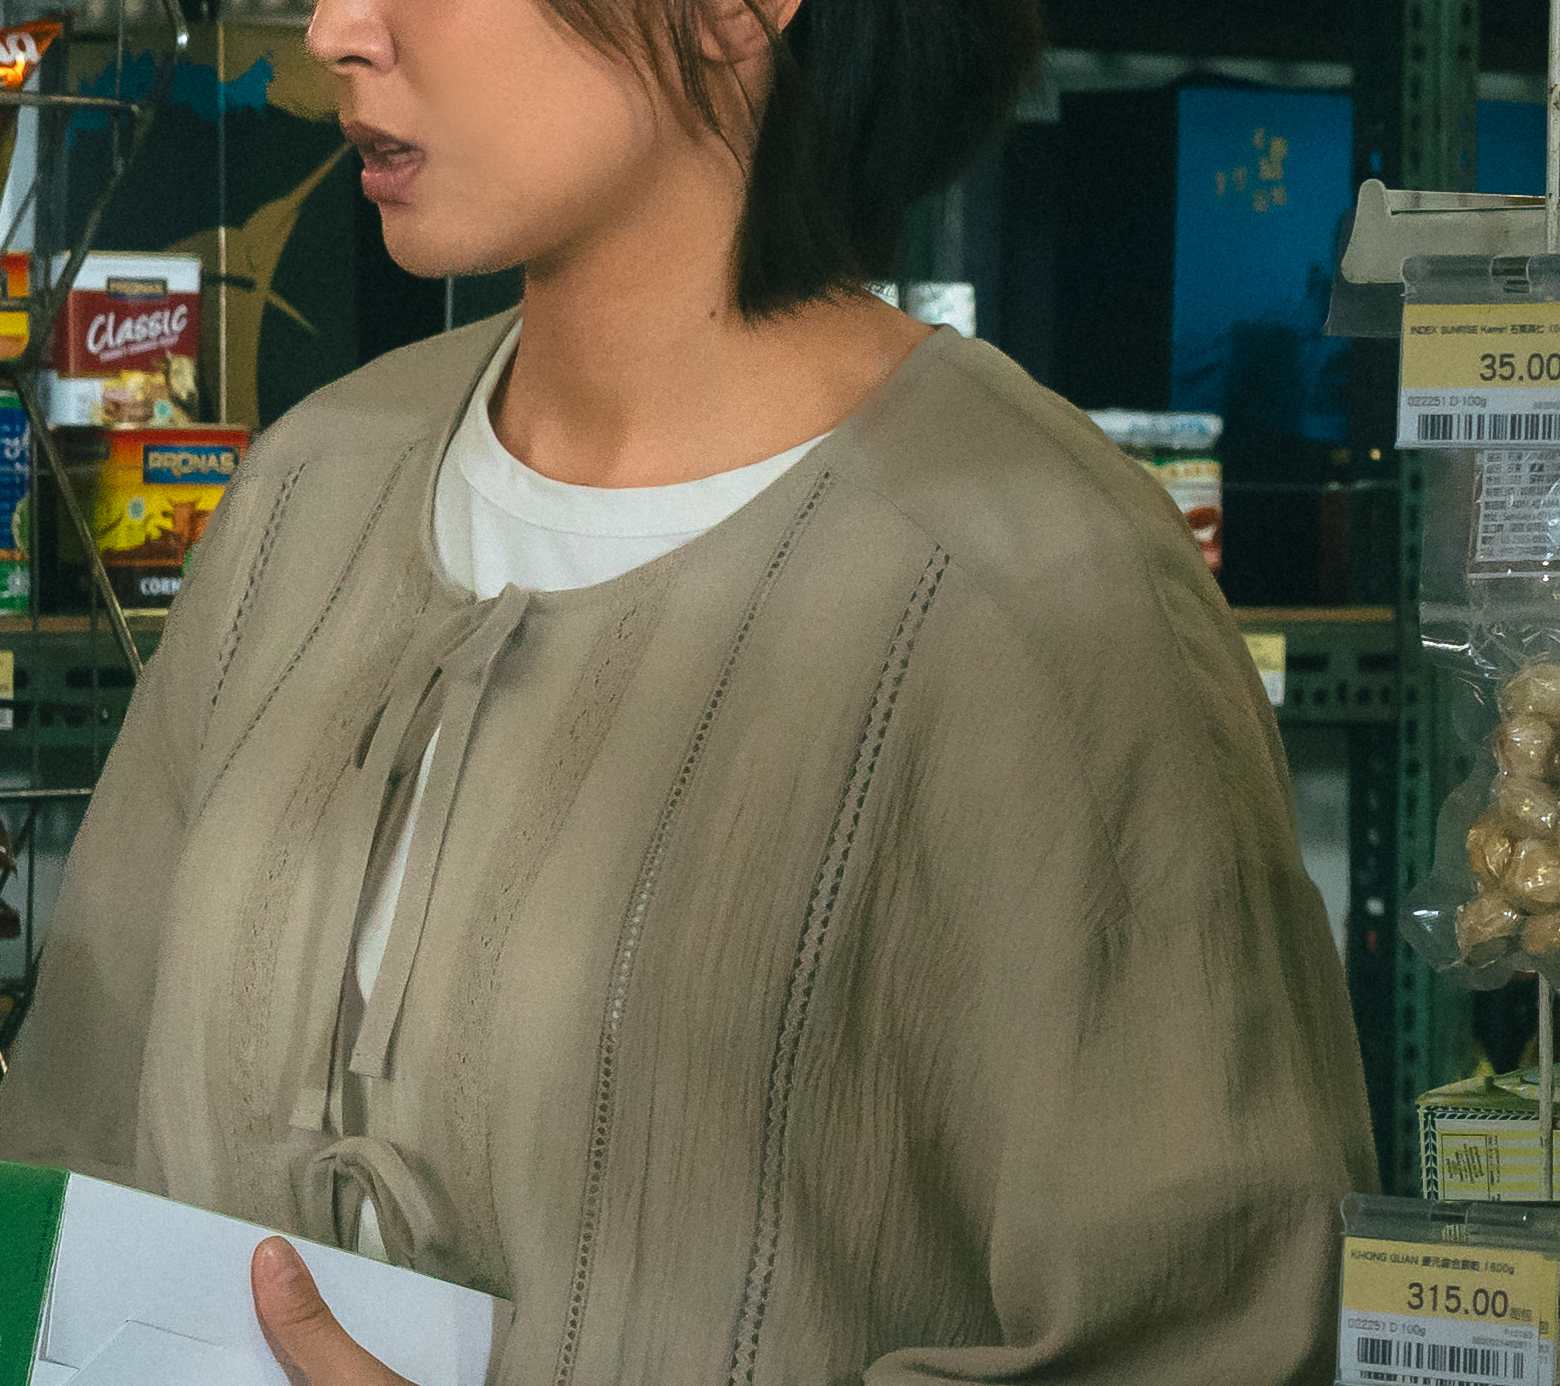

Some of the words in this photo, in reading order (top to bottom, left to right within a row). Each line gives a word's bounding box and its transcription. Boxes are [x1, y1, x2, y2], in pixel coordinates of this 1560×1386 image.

[87, 304, 188, 355] Classic
[1479, 352, 1560, 381] 35.00
[140, 576, 183, 596] CORN
[1350, 1250, 1387, 1262] KHONG
[1407, 1282, 1509, 1318] 315.00
